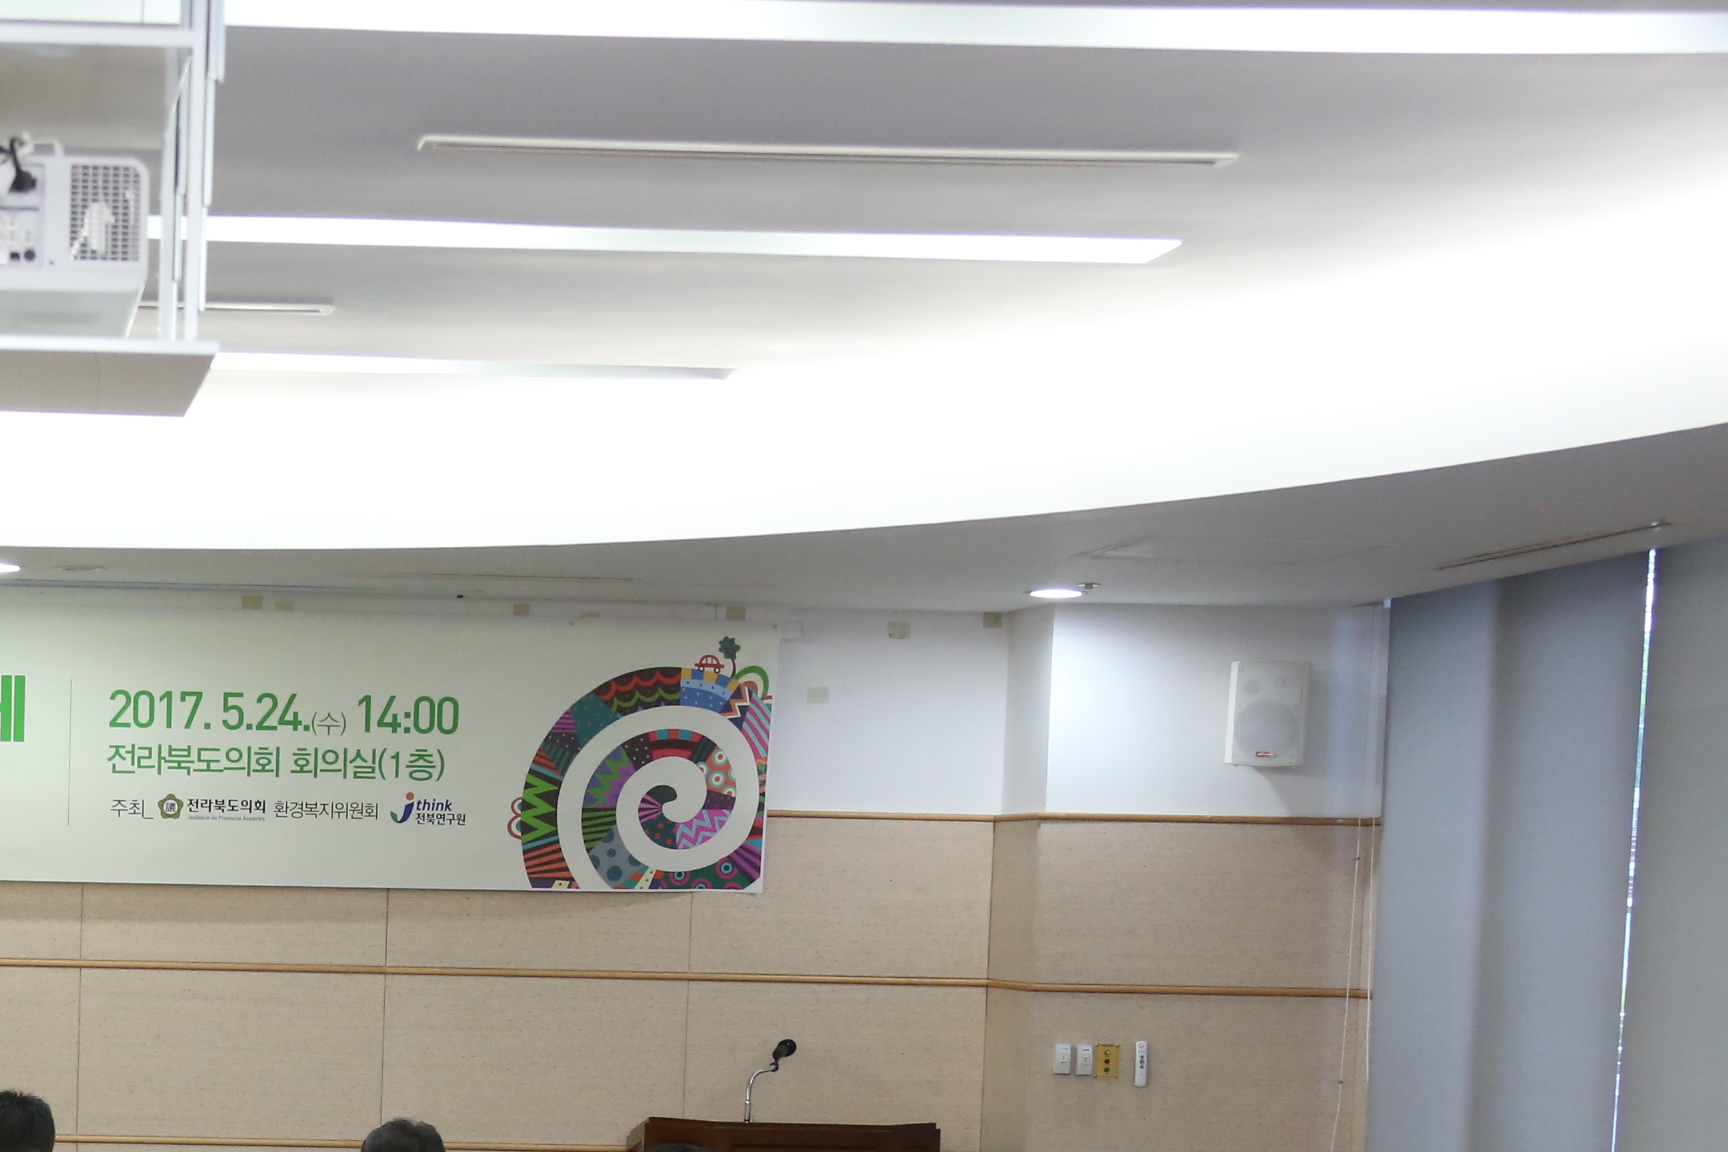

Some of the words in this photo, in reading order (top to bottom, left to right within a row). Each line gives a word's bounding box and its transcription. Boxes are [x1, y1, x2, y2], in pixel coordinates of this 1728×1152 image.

[108, 689, 211, 730] 2017.
[356, 695, 460, 735] 14:00
[106, 744, 281, 779] 전라북도의회
[290, 747, 445, 782] 회의실(1층)
[186, 798, 267, 814] 전라북도의회
[273, 799, 379, 820] 환경복지위원회
[416, 799, 453, 812] think
[415, 812, 467, 826] 전북연구원
